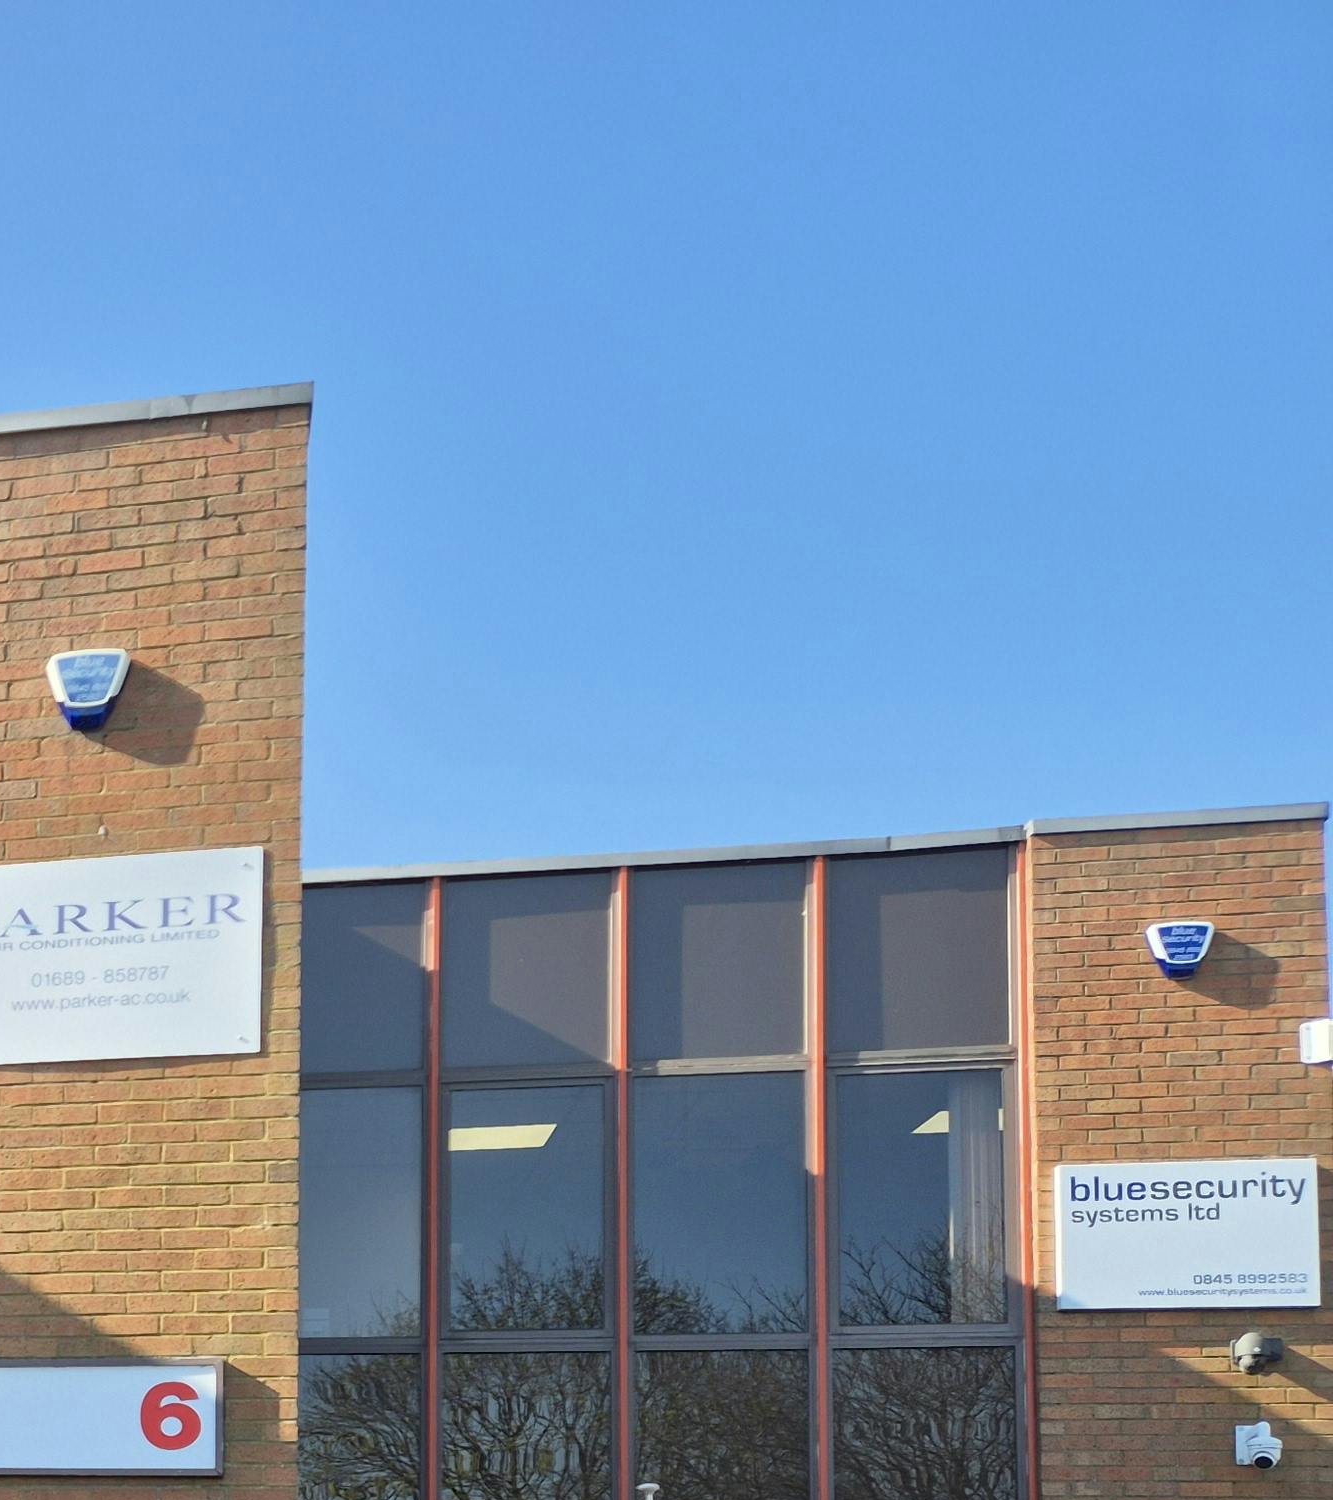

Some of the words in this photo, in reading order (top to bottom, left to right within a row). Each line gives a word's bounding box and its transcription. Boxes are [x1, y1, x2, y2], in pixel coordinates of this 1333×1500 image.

[19, 934, 145, 951] CONDITIONING
[151, 928, 220, 943] LIMITED
[31, 970, 86, 988] 01689
[103, 965, 170, 984] 858787
[11, 988, 191, 1012] www.parker-ac.co.uk
[1070, 1171, 1306, 1205] bluesecurity
[1071, 1206, 1179, 1227] systems
[1188, 1203, 1220, 1221] ltd
[1193, 1274, 1233, 1285] 0845
[140, 1381, 202, 1450] 6
